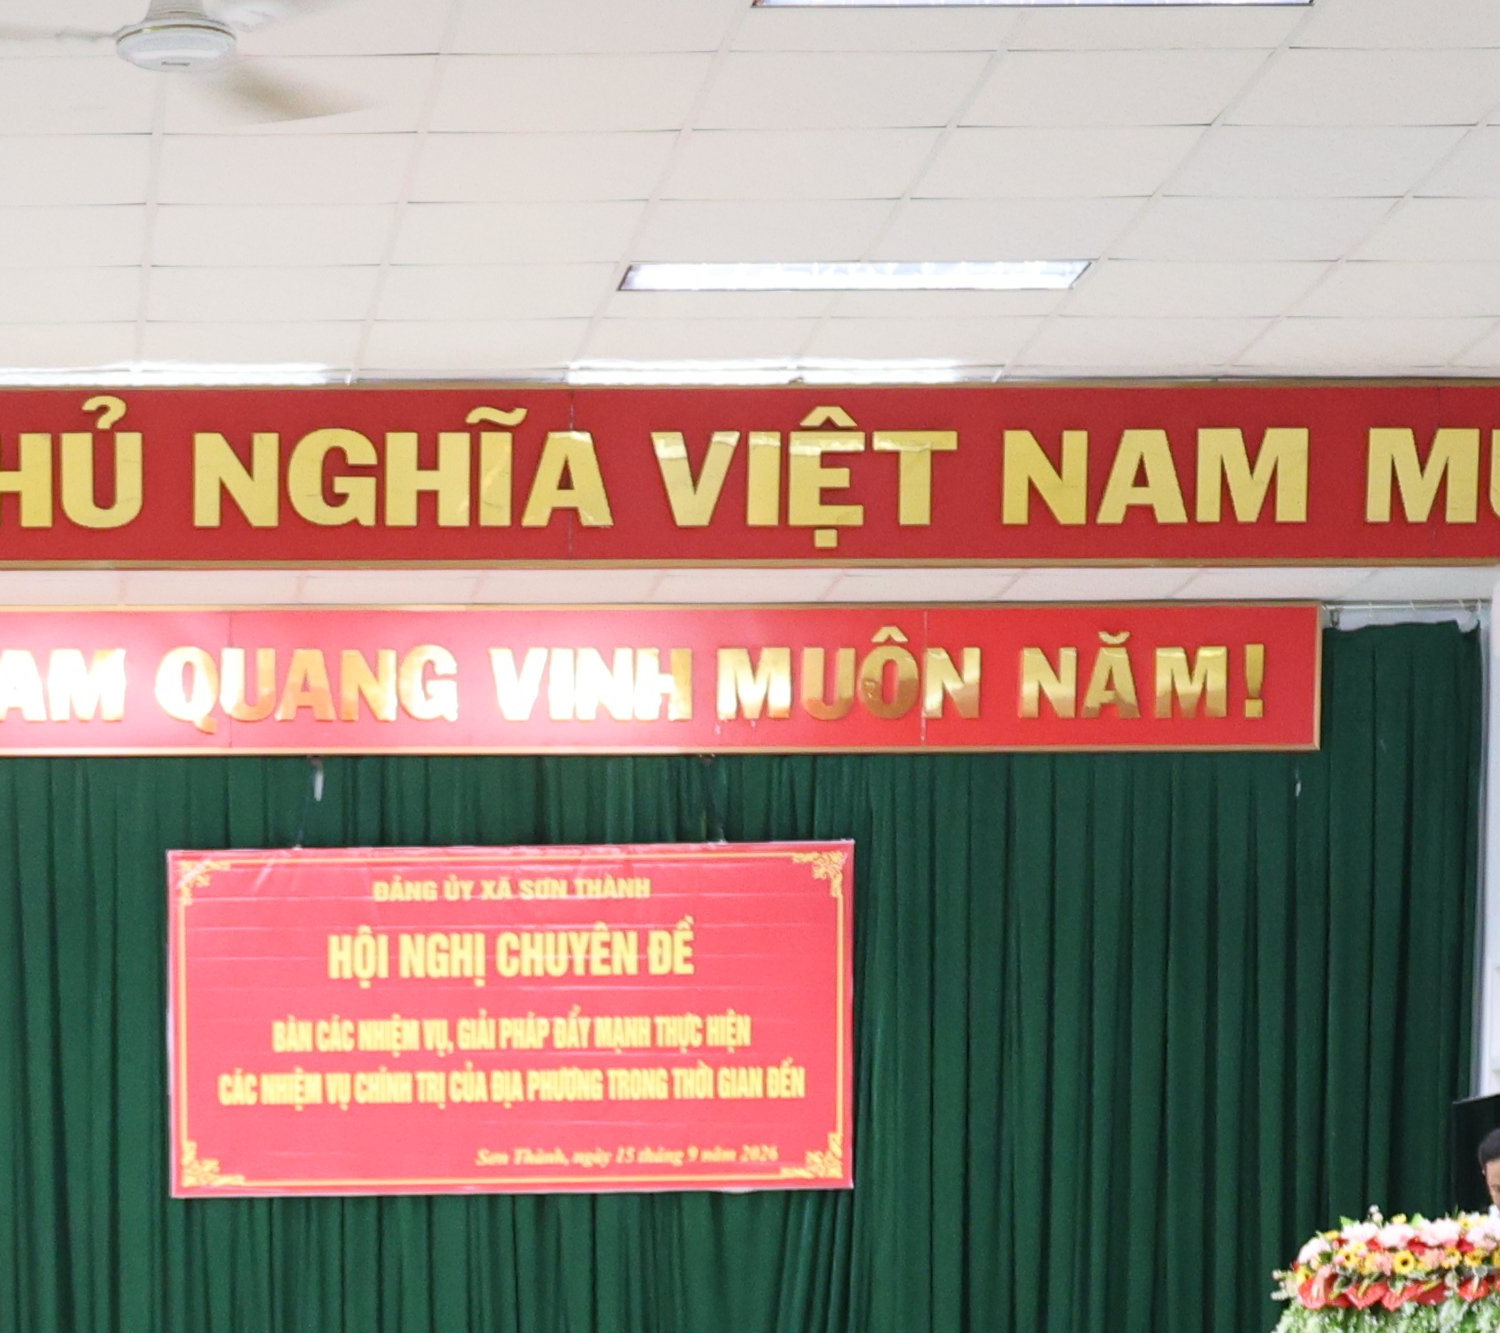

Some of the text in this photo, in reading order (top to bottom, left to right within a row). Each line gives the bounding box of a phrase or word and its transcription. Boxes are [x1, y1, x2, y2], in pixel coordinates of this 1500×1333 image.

[193, 406, 612, 528] NGHĨA
[652, 405, 958, 547] VIỆT
[1002, 427, 1309, 525] NAM
[155, 646, 458, 734] QUANG
[490, 647, 693, 723] VINH
[716, 626, 980, 721] MUÔN
[1018, 631, 1264, 719] NĂM!
[373, 876, 437, 902] ĐẢNG
[574, 873, 651, 899] THÀNH
[328, 914, 695, 988] HỘI NGHỊ CHUYÊN ĐỀ
[594, 1016, 651, 1054] MẠNH
[706, 1007, 751, 1053] HIỆN
[260, 1065, 323, 1111] NHIỆM
[415, 1071, 446, 1109] TRỊ
[606, 1068, 669, 1100] TRONG
[717, 1067, 763, 1099] GIAN
[687, 1146, 698, 1162] 9
